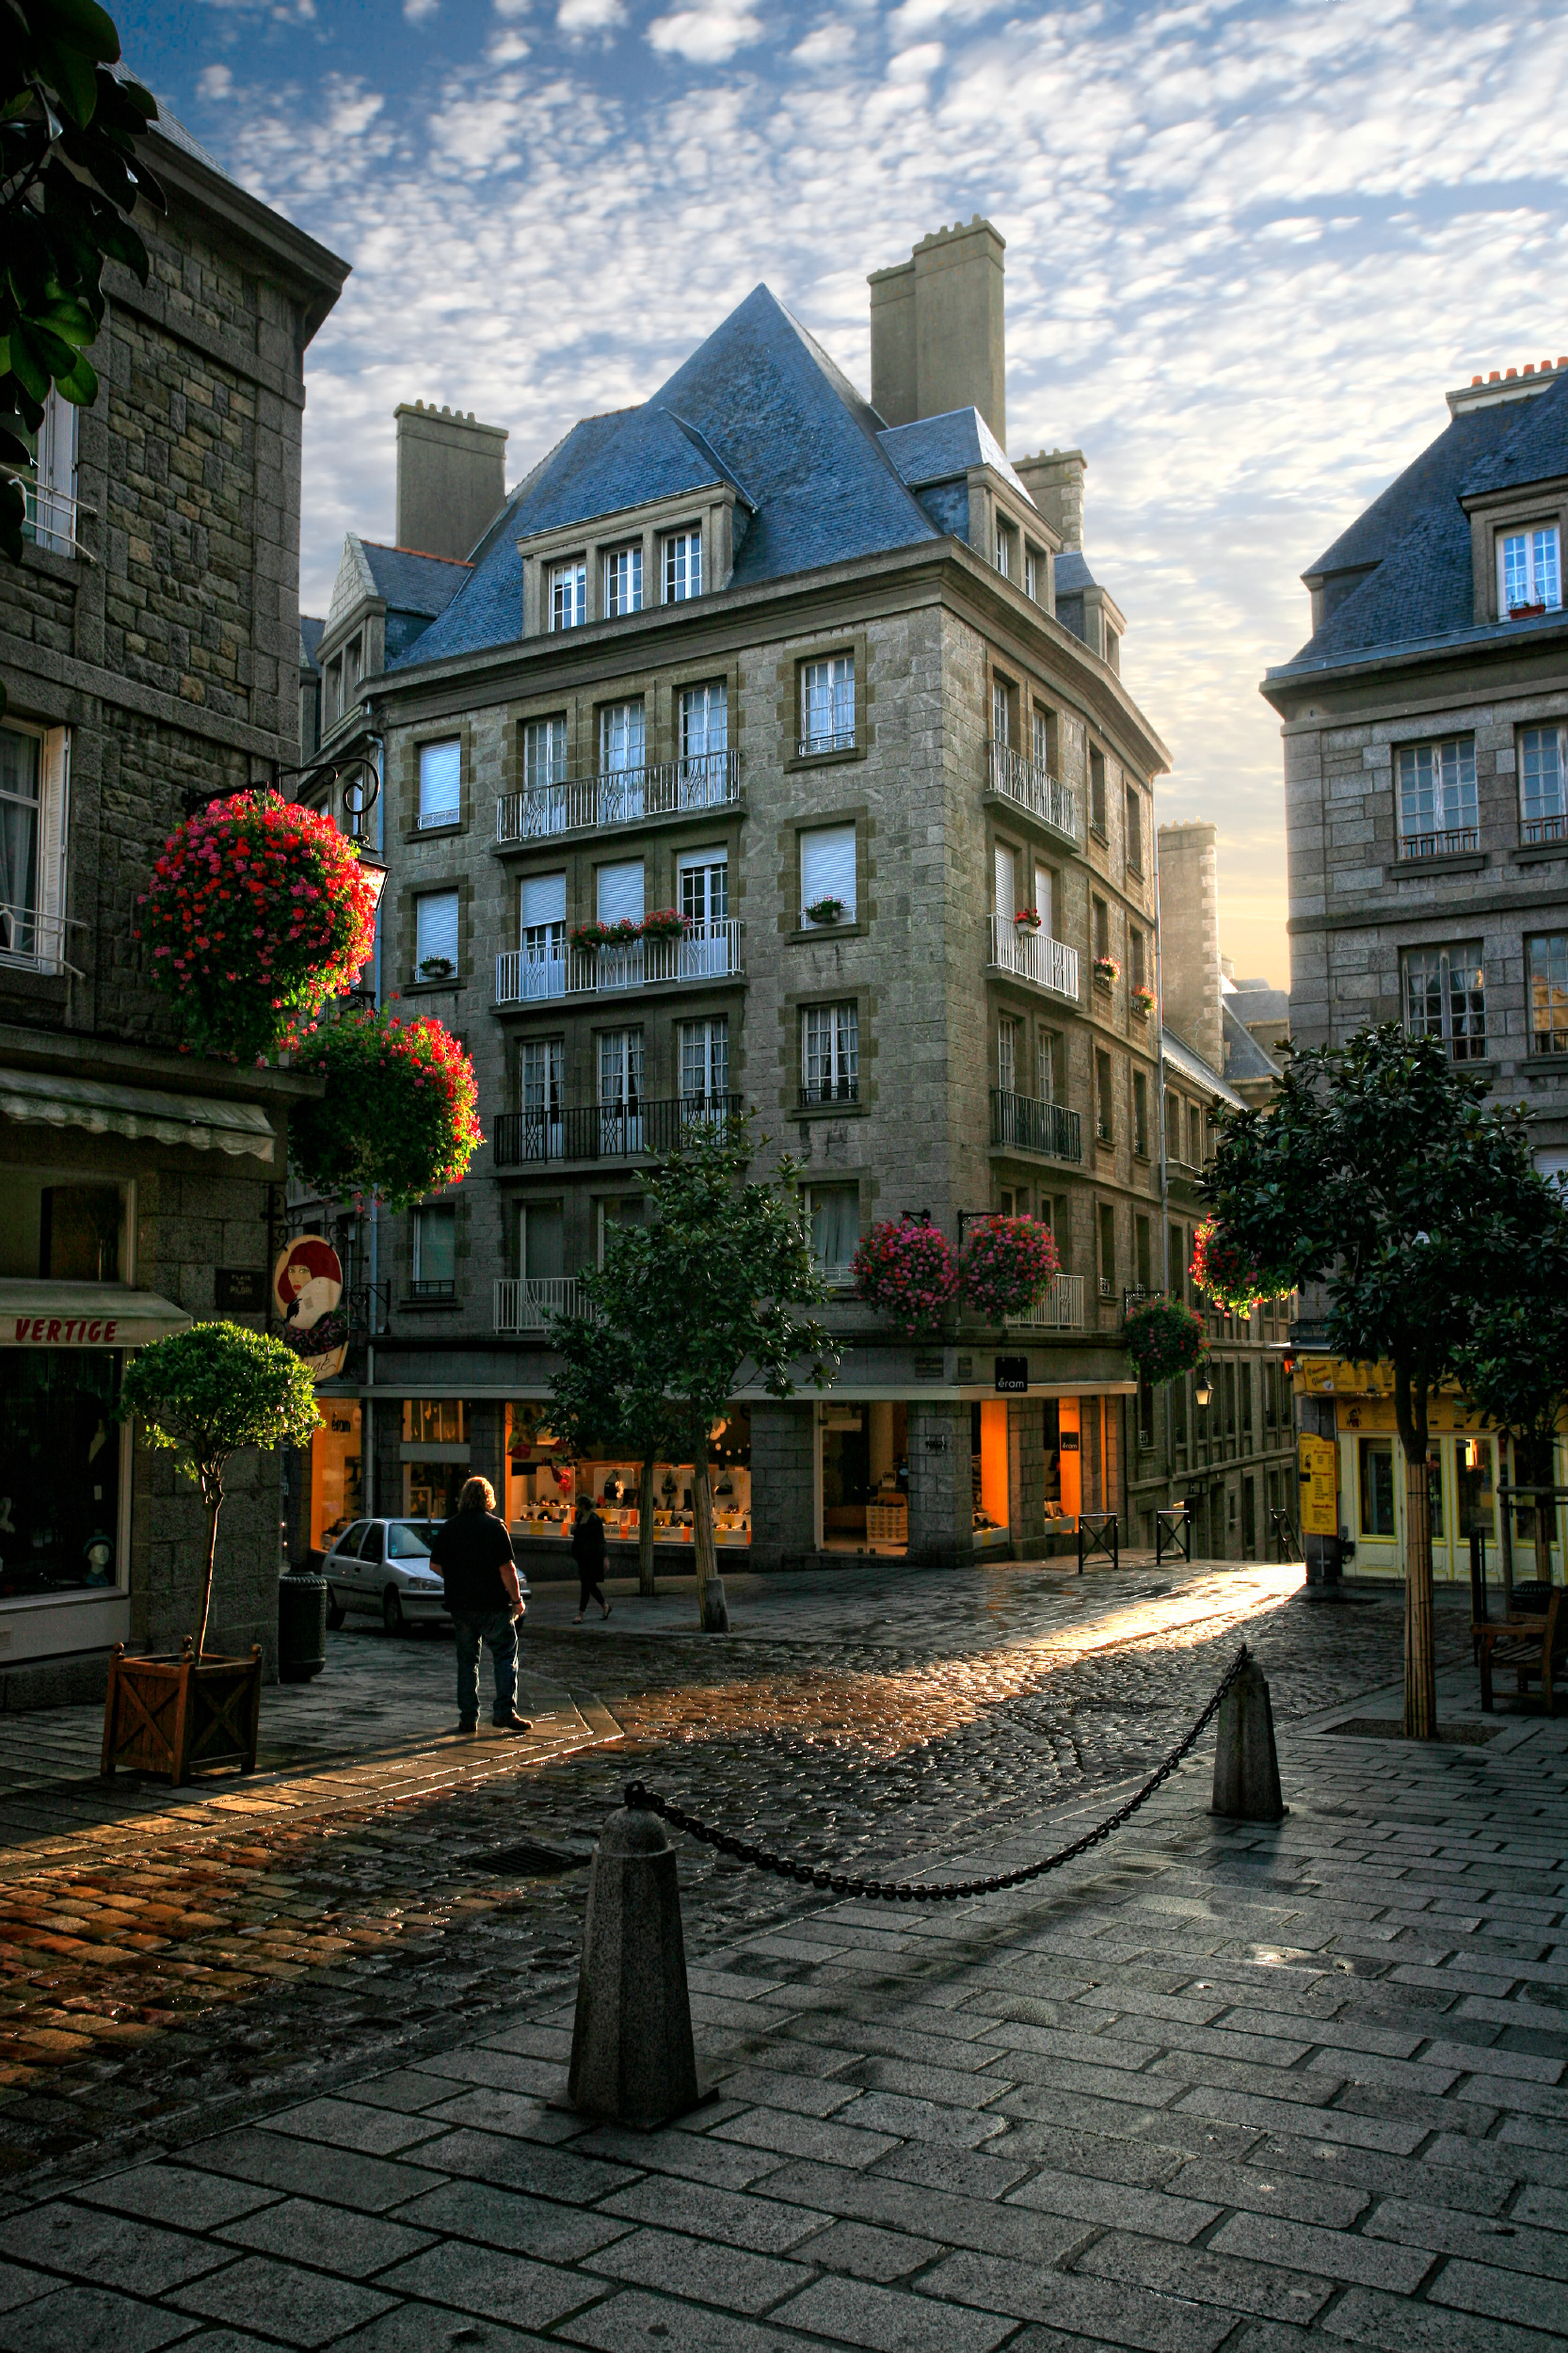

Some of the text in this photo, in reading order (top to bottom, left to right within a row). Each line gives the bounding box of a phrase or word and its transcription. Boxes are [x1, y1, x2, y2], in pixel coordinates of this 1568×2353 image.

[231, 1286, 253, 1295] PILORI
[15, 1318, 118, 1342] VERTIGE
[998, 1376, 1024, 1388] éram
